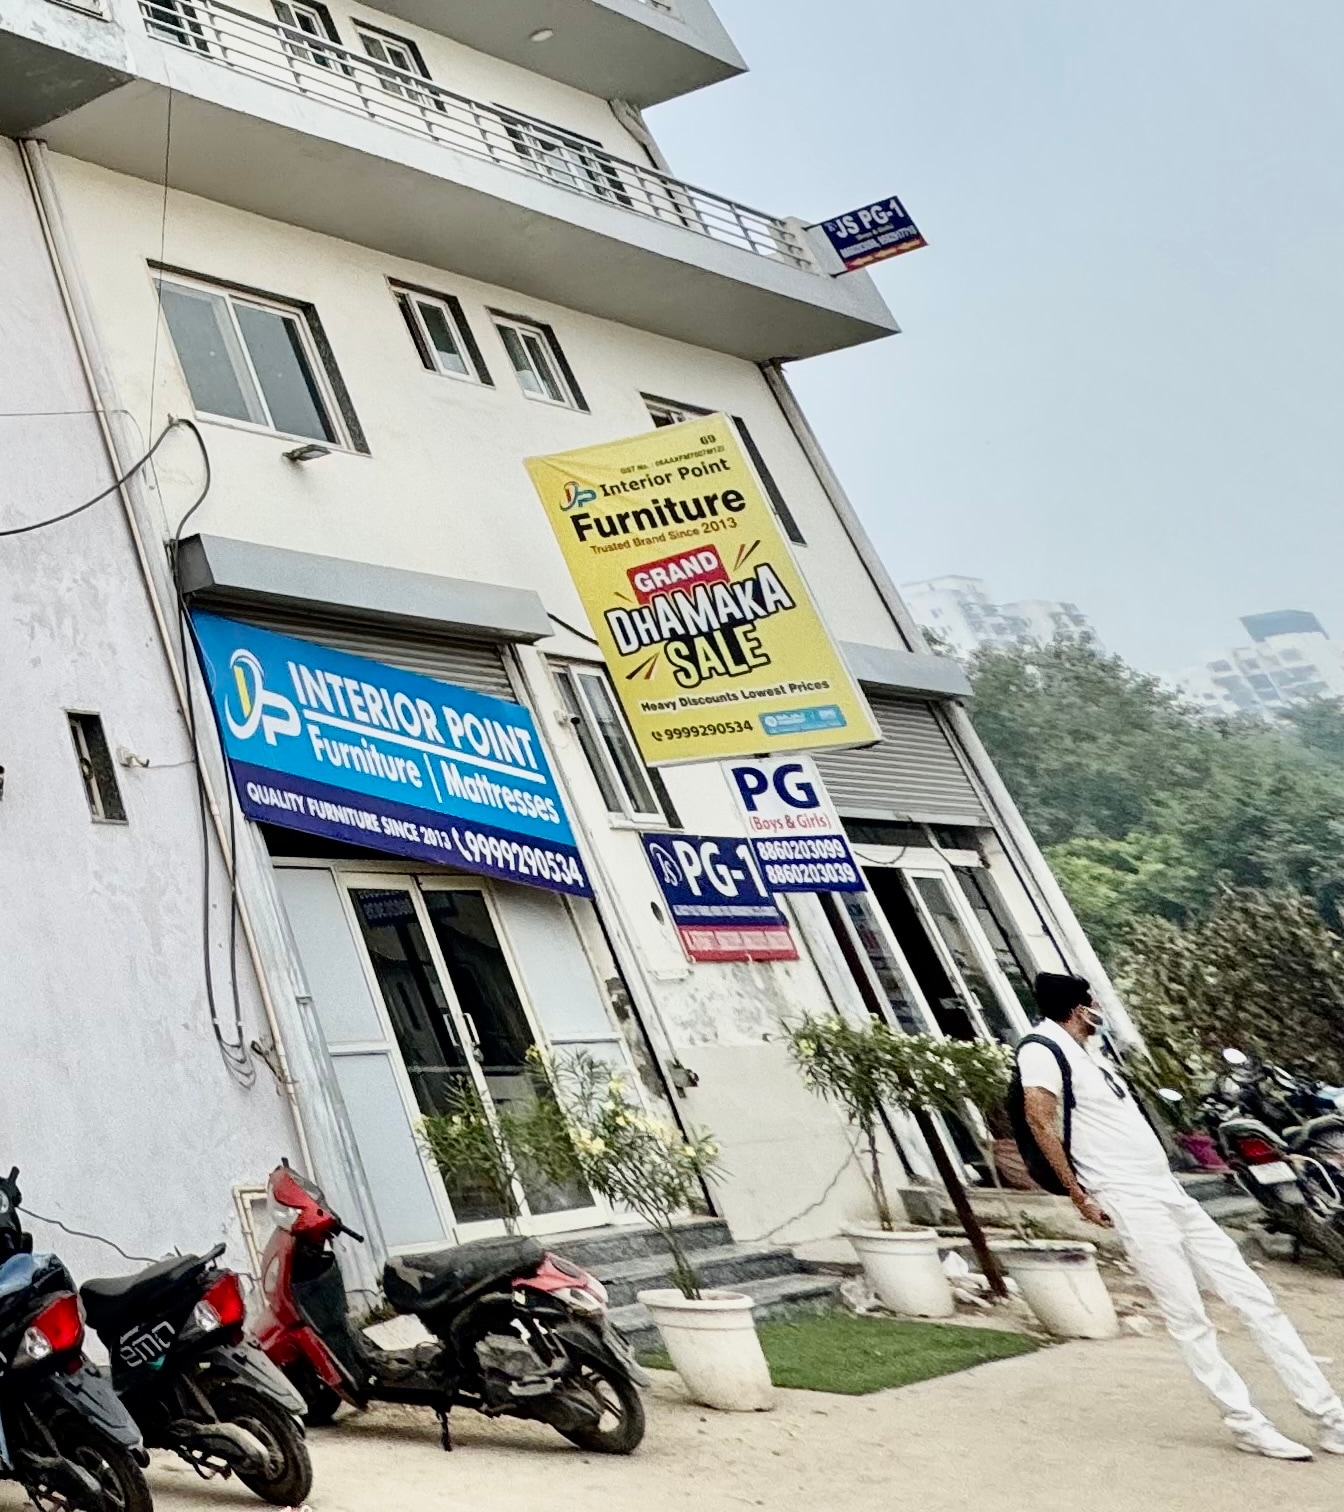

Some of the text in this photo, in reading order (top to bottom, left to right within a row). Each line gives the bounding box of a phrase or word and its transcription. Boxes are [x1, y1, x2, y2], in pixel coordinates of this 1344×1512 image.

[857, 199, 904, 230] PG-1
[599, 469, 672, 498] Interior
[677, 457, 731, 481] Point
[570, 488, 746, 542] Furniture
[590, 516, 738, 555] Trusted Brand Since 2013
[633, 550, 720, 593] GRAND
[605, 563, 795, 656] DHAMAKA
[665, 623, 771, 689] SALE
[287, 659, 440, 744] INTERIOR
[445, 704, 540, 771] POINT
[640, 679, 830, 713] Heavy Discounts Lowest Prices
[664, 720, 753, 740] 9999290534
[307, 722, 561, 825] Furniture Mattresses
[731, 763, 820, 812] PG
[246, 782, 584, 888] QUALITY FURNITURE SINCE 2013 9999290534
[749, 813, 831, 832] (Boys & Girls)
[672, 840, 770, 898] PG-1
[758, 838, 846, 861] 8860203099
[765, 862, 857, 884] 8860203039
